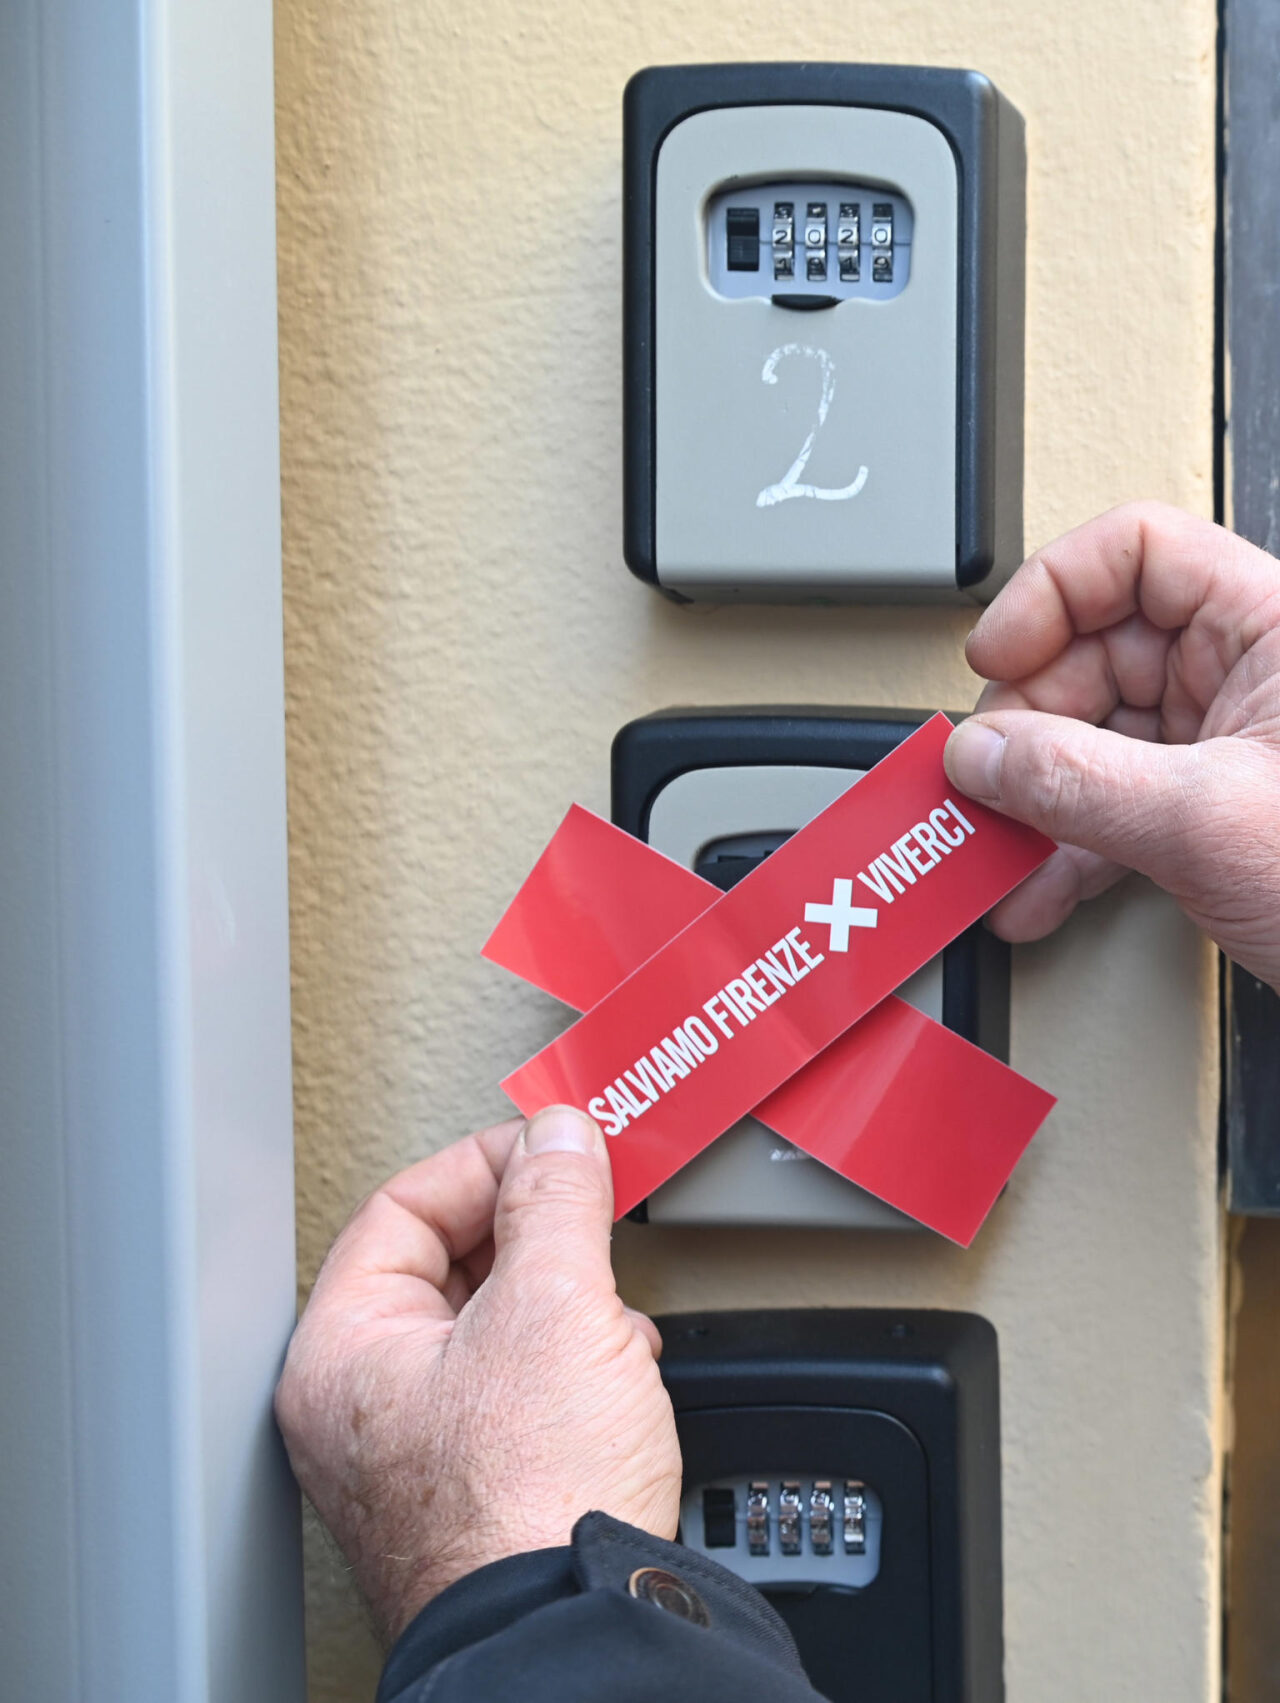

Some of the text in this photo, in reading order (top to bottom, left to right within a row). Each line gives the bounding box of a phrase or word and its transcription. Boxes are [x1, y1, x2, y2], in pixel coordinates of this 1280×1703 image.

[756, 344, 868, 508] 2
[588, 1015, 719, 1136] SALVIAMO
[703, 927, 825, 1039] FIRENZE
[857, 799, 976, 903] VIVERCI
